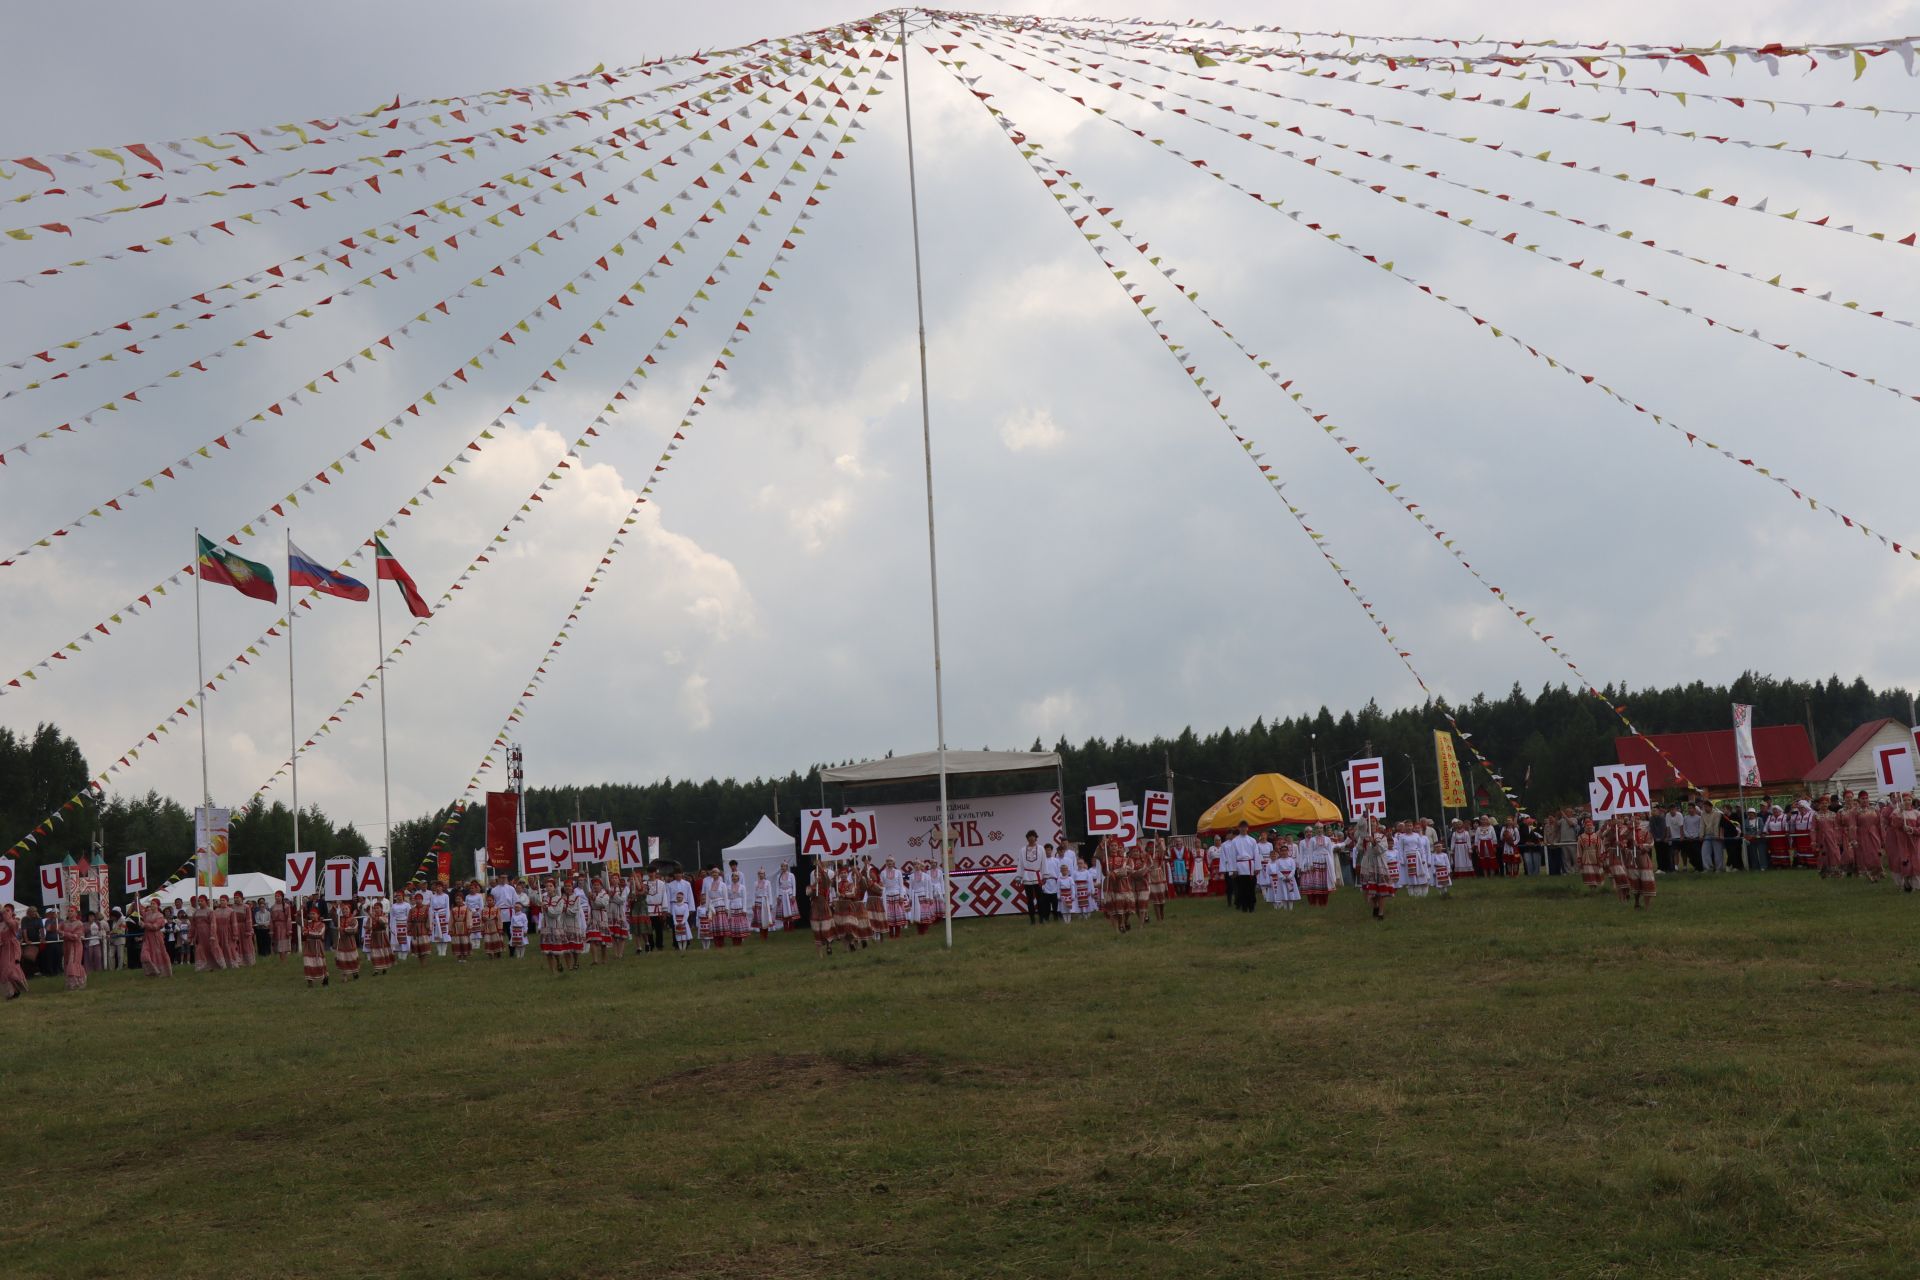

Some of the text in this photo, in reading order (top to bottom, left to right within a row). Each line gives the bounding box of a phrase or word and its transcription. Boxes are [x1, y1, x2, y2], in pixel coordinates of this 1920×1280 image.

[1352, 763, 1382, 799] Е
[1880, 748, 1906, 784] Г
[1613, 770, 1649, 808] Ж
[1145, 793, 1169, 828] Ё
[523, 840, 548, 874] Е
[572, 824, 597, 858] Щ
[620, 835, 640, 864] К
[42, 868, 64, 898] Ч
[127, 856, 145, 888] Ц
[287, 857, 314, 892] У
[327, 864, 350, 895] Т
[359, 861, 383, 892] А
